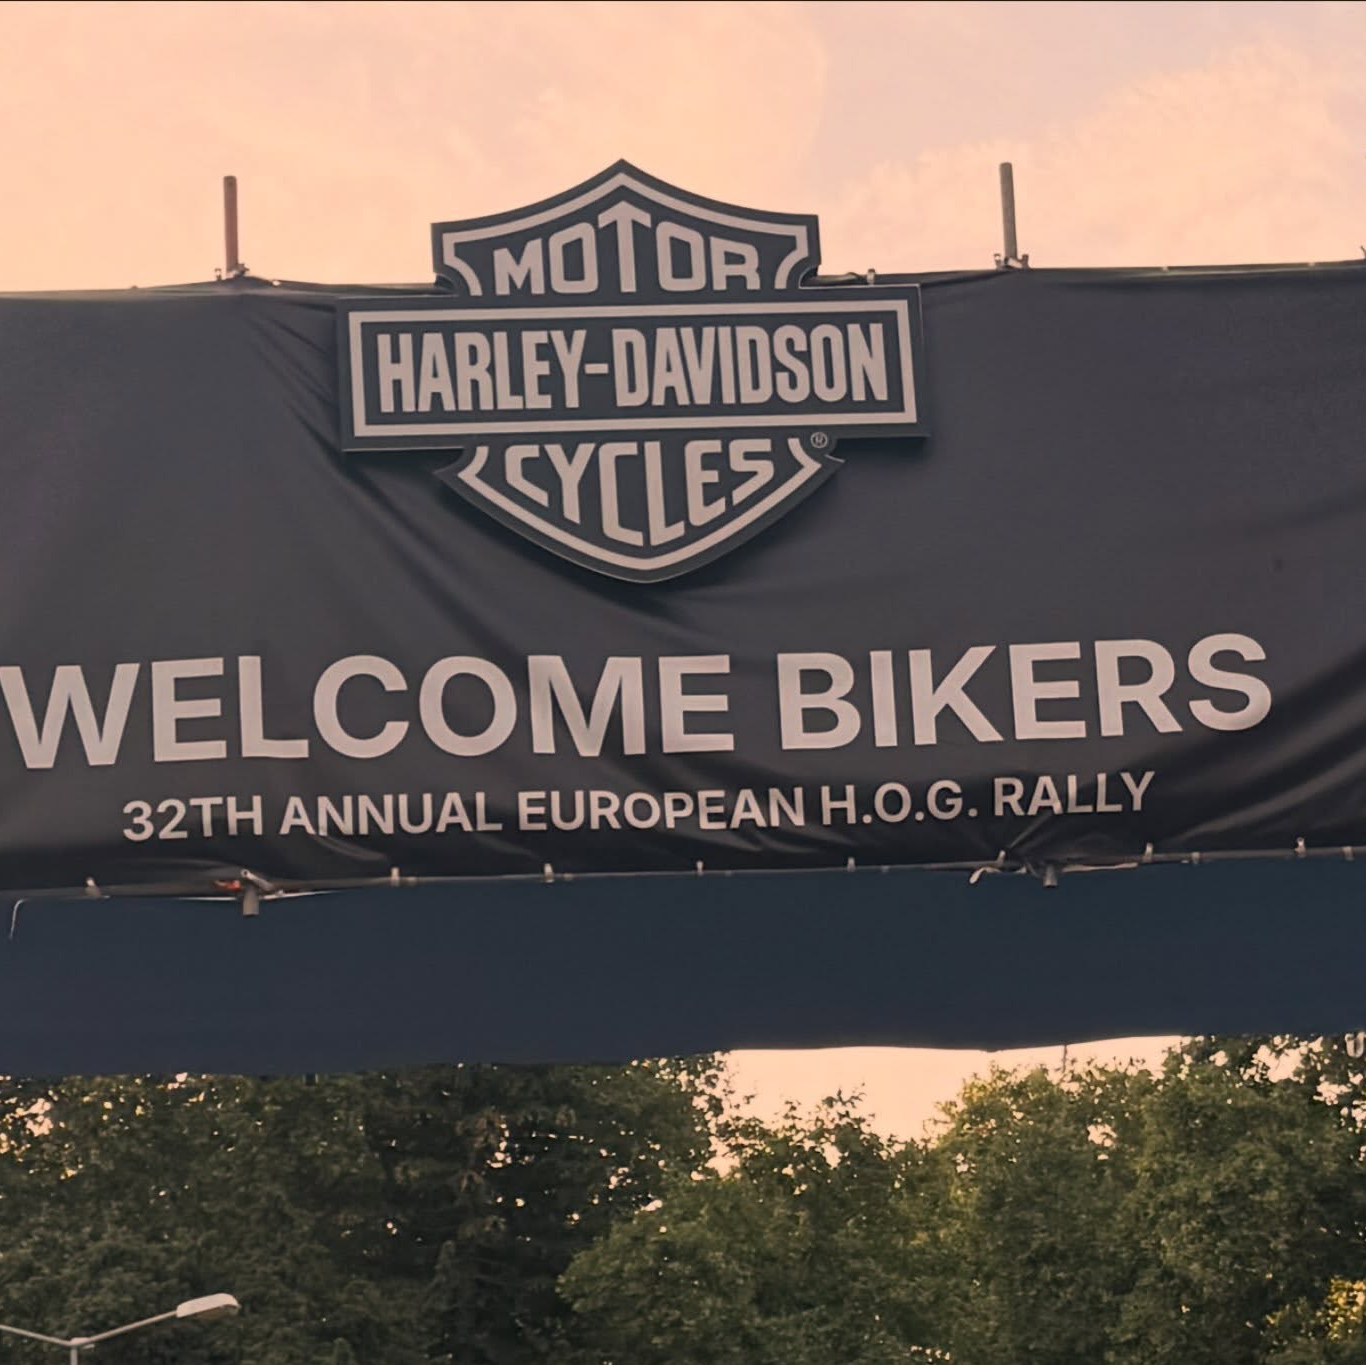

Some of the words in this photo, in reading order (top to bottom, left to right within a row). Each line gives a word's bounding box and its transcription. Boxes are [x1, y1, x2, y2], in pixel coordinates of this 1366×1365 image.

[493, 201, 761, 295] MOTOR
[377, 322, 888, 413] HARLEY-DAVIDSON
[505, 438, 774, 547] CYCLES
[777, 633, 1273, 750] BIKERS
[122, 796, 262, 841] 32TH
[279, 792, 502, 837] ANNUAL
[518, 786, 805, 831] EUROPEAN
[822, 780, 977, 826] H.O.G.
[993, 771, 1155, 817] RALLY
